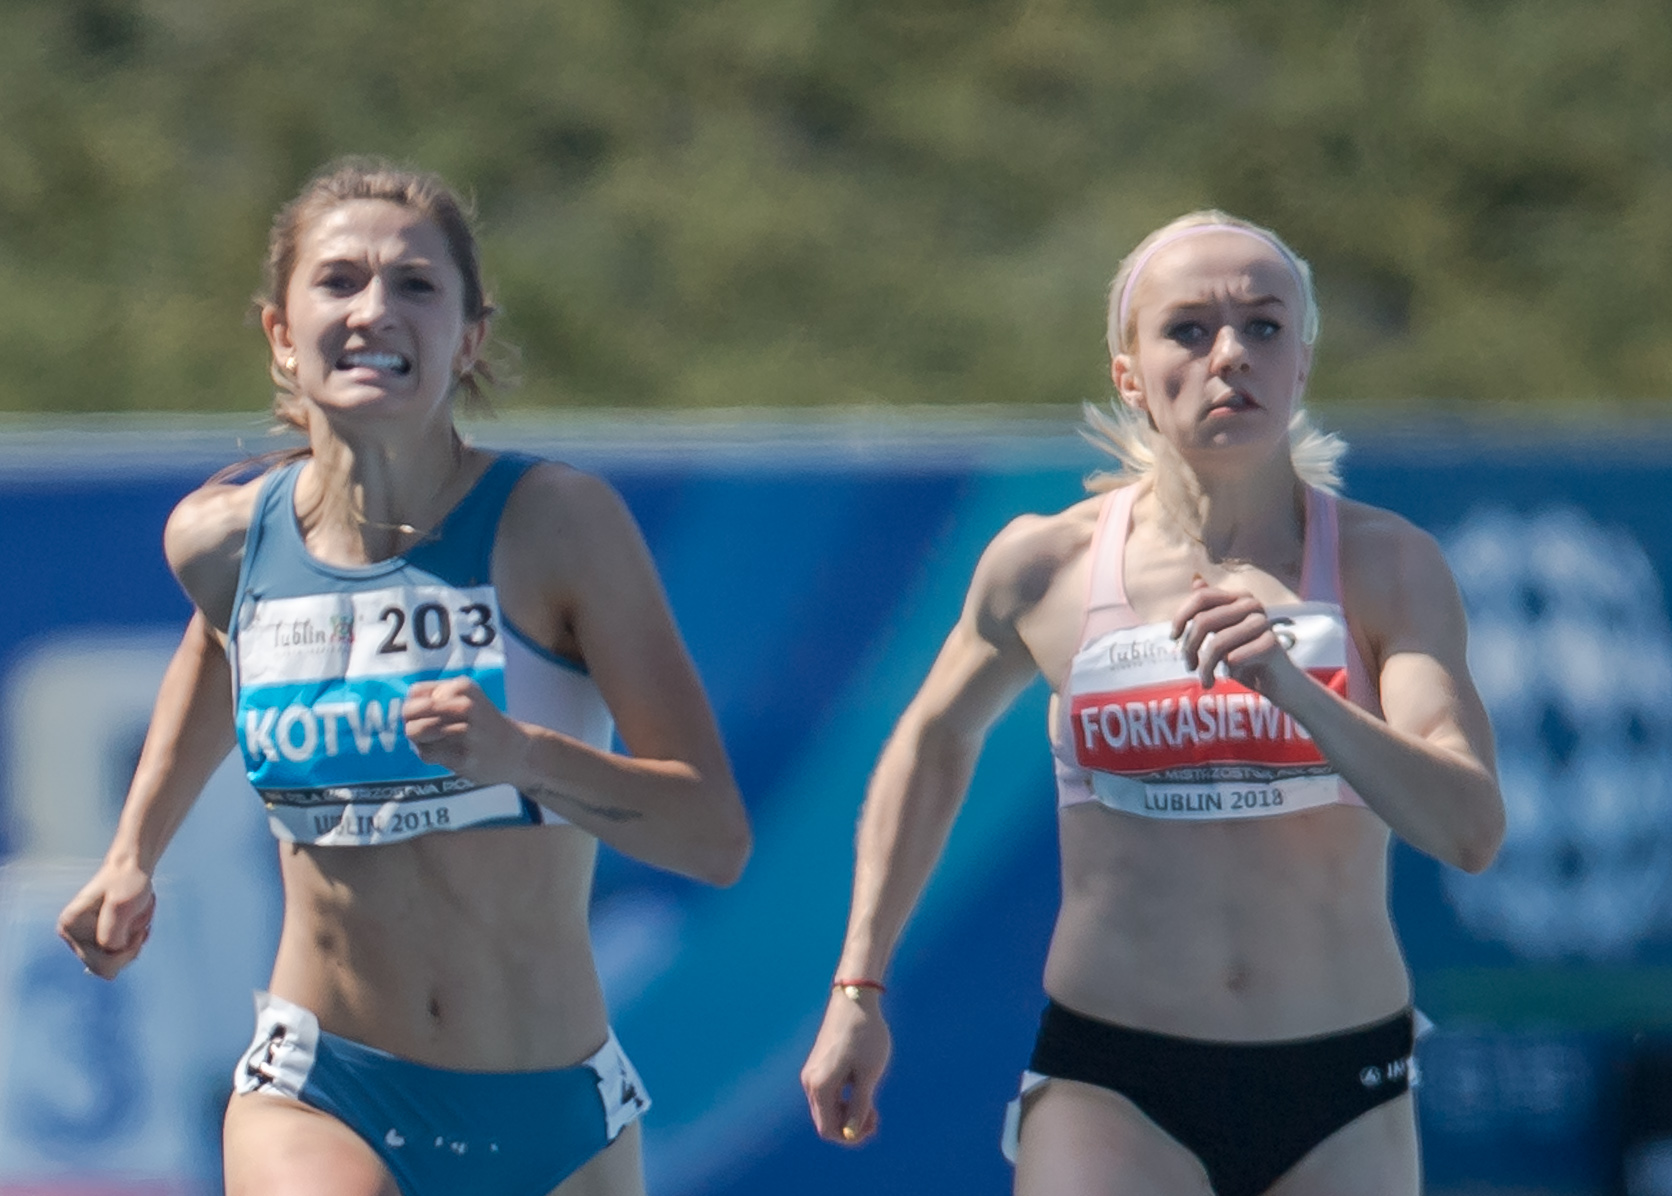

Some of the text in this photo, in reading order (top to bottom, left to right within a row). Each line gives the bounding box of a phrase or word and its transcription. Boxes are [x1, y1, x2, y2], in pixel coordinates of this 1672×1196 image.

[378, 602, 498, 654] 203
[245, 697, 404, 762] KOTW
[1080, 693, 1312, 750] FORKASIEWI
[391, 807, 450, 833] 2018
[1144, 789, 1283, 812] LUBLIN 2018
